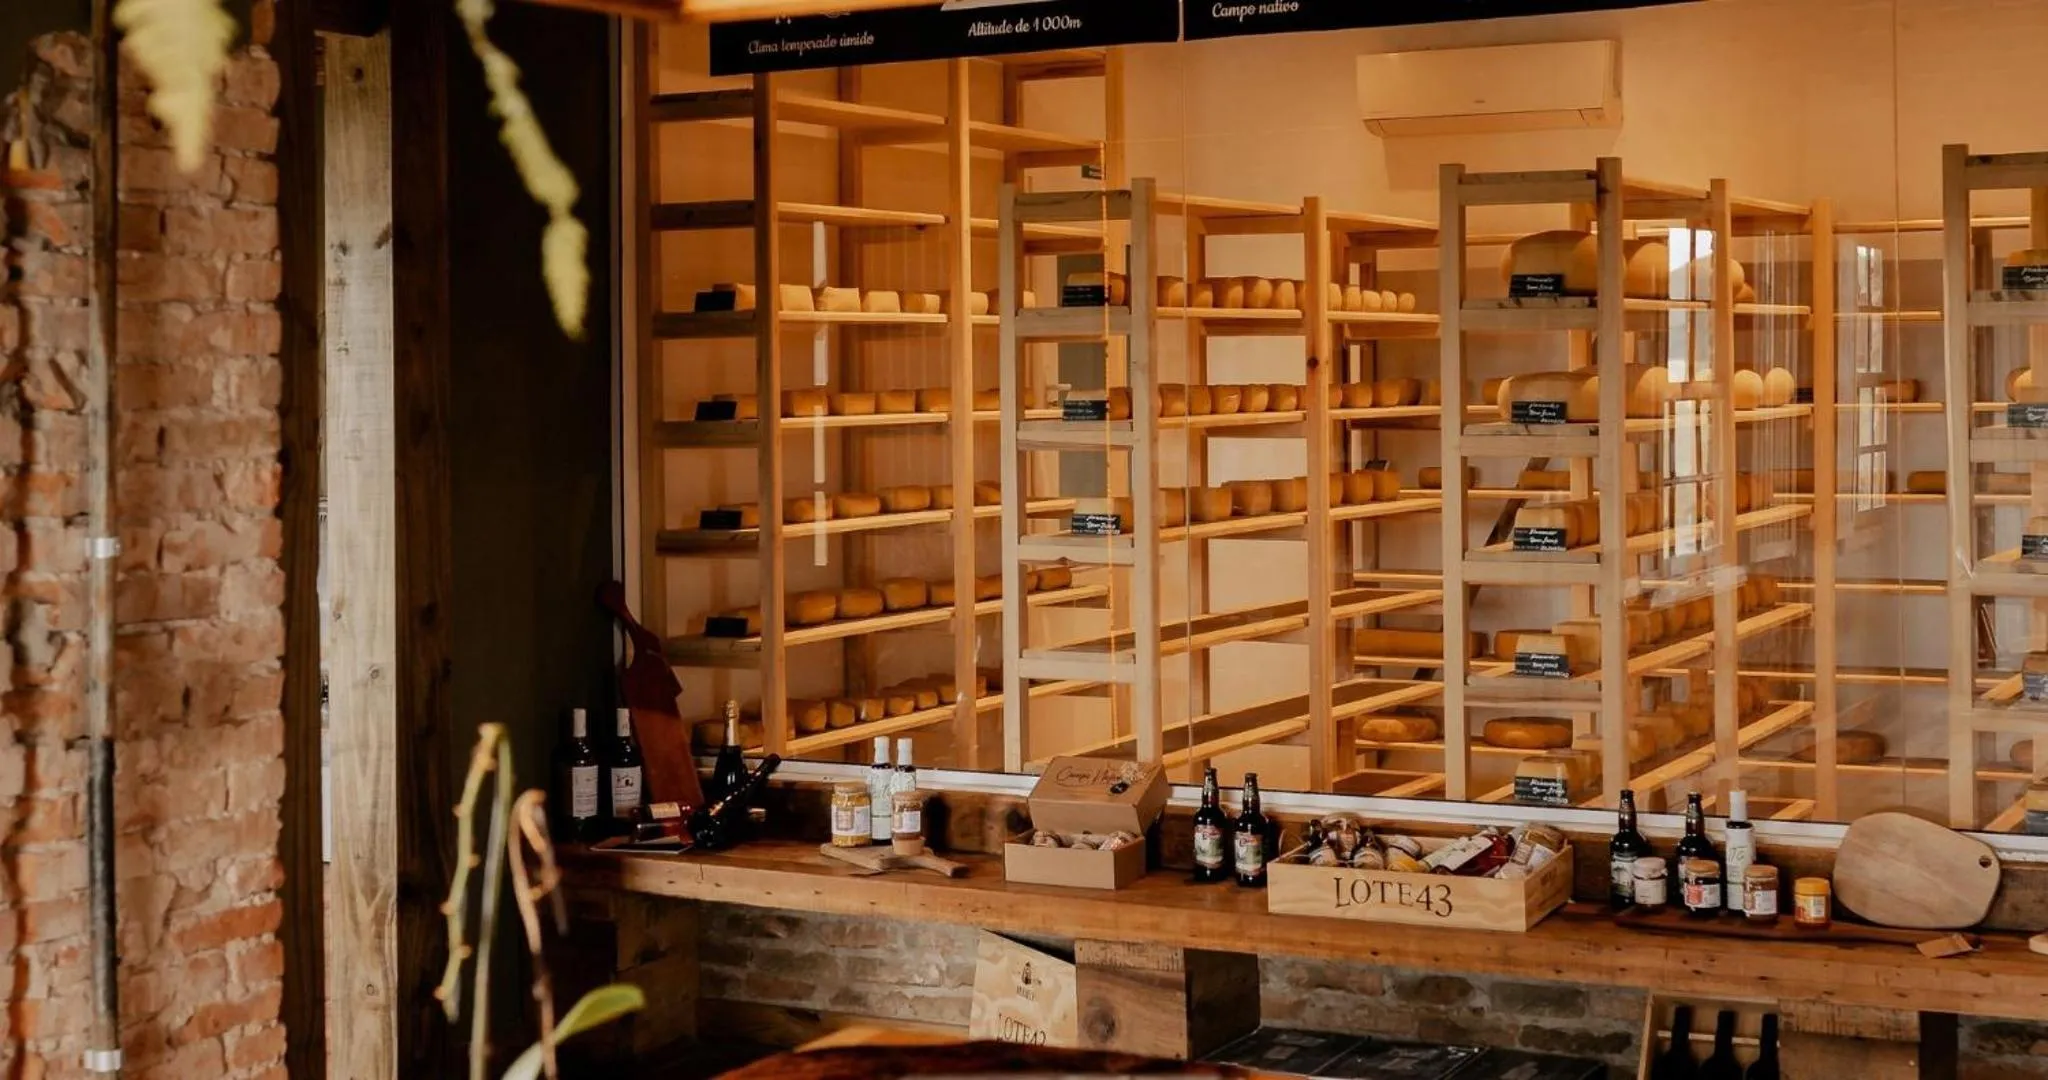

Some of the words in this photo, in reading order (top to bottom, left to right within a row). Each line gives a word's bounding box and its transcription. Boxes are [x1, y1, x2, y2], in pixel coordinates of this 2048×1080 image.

[1212, 2, 1256, 22] Campo
[1259, 0, 1299, 14] nativo
[968, 19, 1013, 37] Altitude
[1015, 17, 1030, 33] de
[748, 40, 778, 54] Clima
[781, 33, 837, 56] temperado
[839, 30, 875, 48] úmido
[1333, 877, 1453, 918] LOTE43
